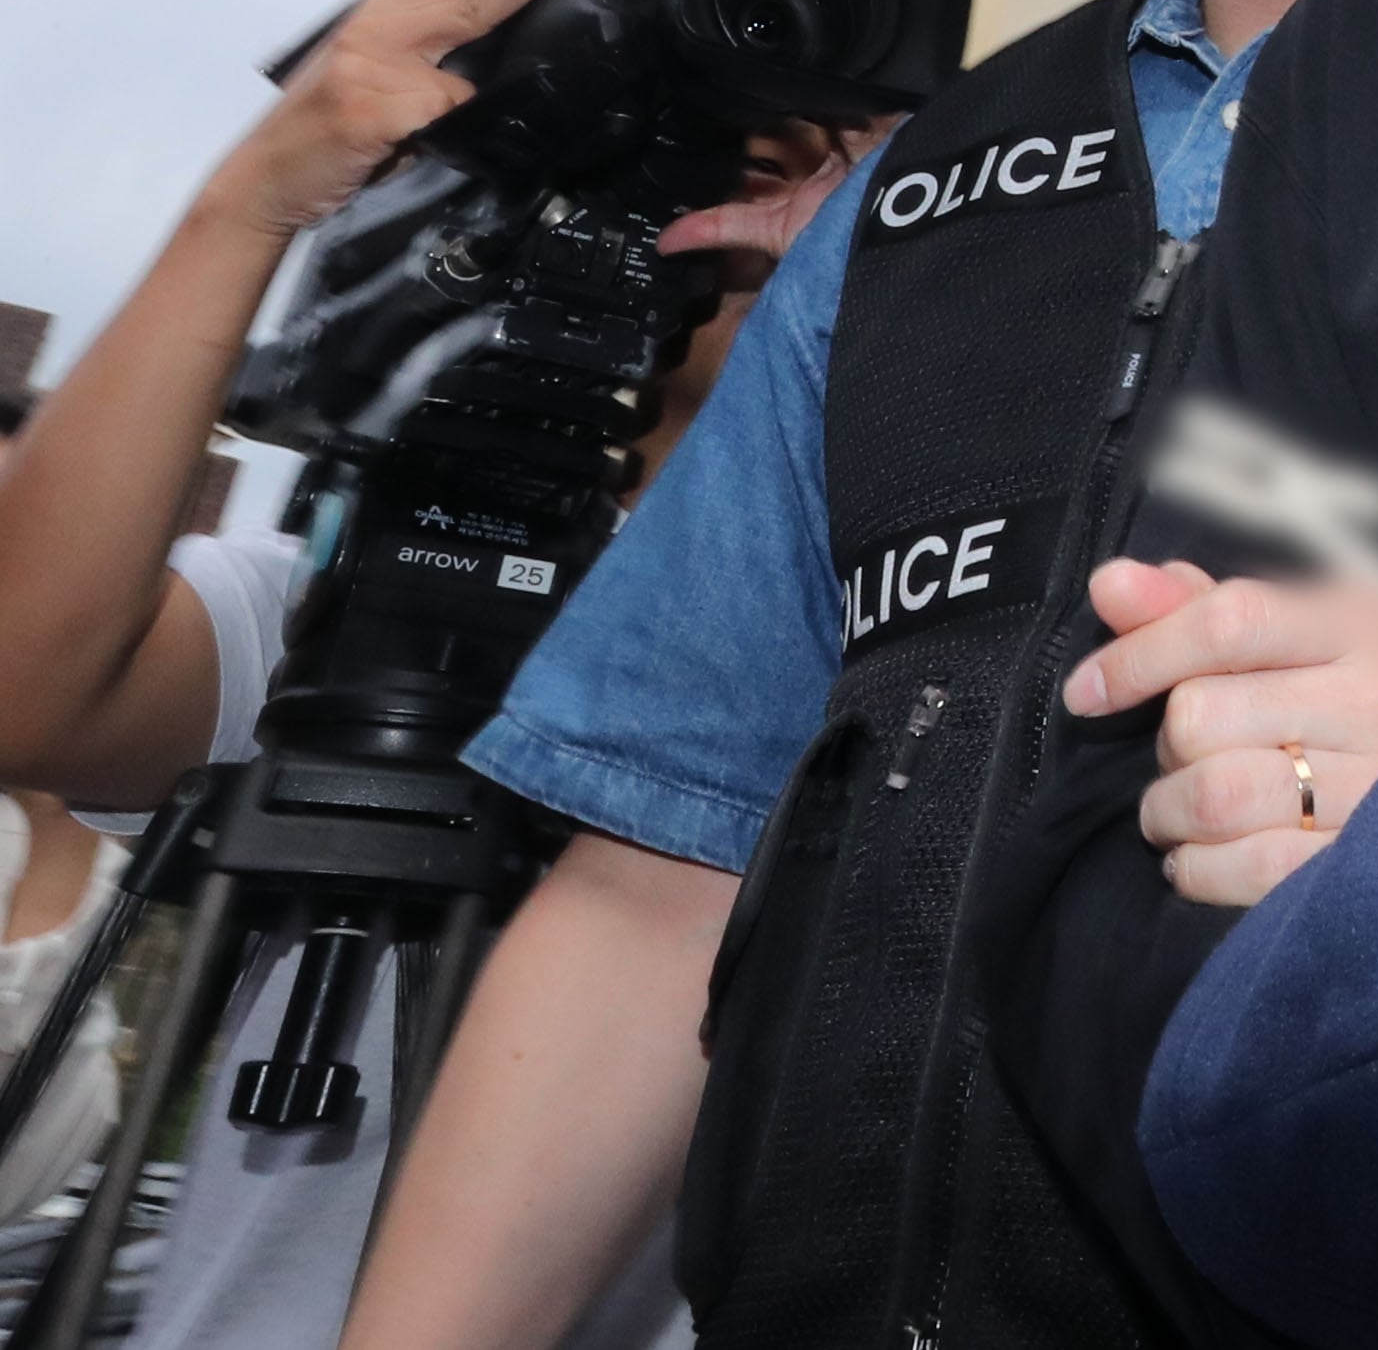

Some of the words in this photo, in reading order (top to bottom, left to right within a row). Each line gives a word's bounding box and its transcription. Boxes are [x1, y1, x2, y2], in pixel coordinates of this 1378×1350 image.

[871, 128, 1116, 228] OLICE
[1121, 353, 1141, 388] POLICE
[398, 546, 480, 572] arrow
[508, 563, 545, 586] 25
[840, 518, 1007, 654] LICE
